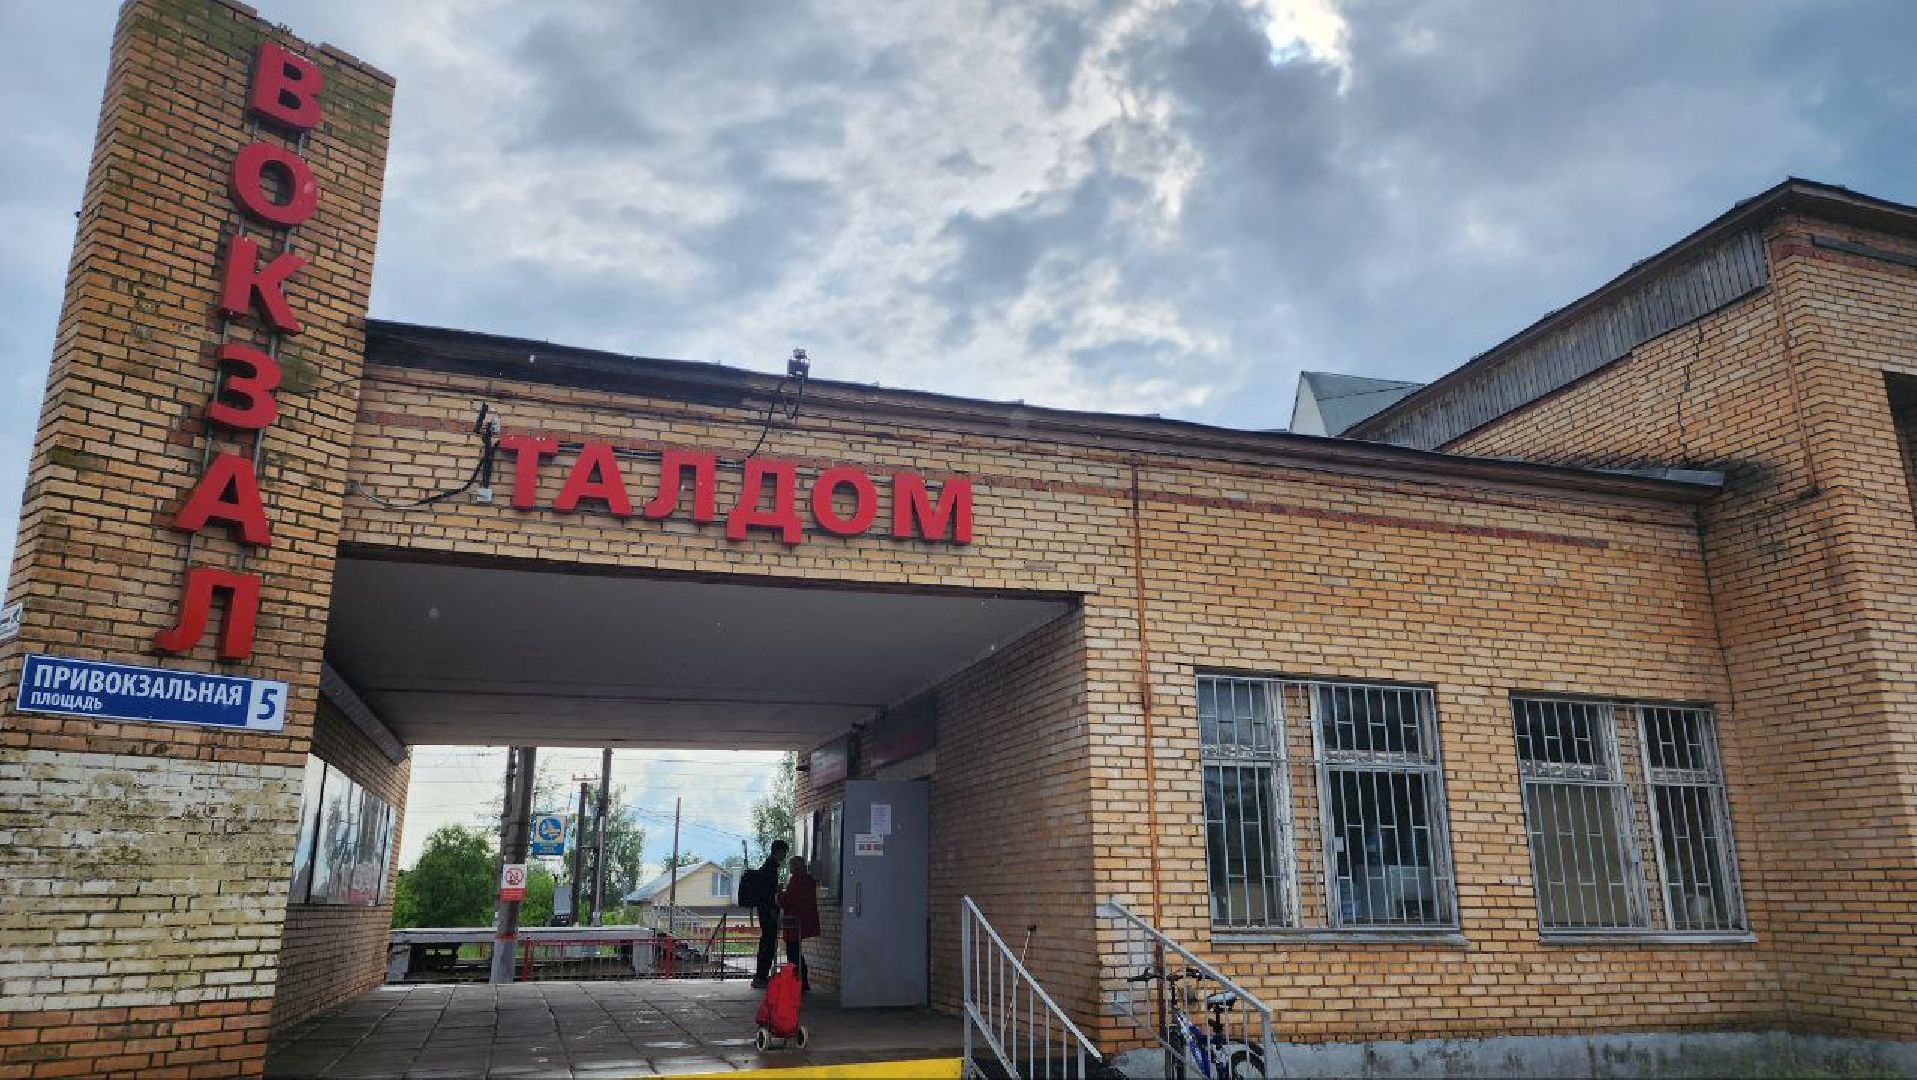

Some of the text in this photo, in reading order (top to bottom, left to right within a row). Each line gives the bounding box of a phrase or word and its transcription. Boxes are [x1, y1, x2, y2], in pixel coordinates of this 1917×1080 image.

[153, 41, 324, 661] ВОКЗАЛ
[499, 435, 974, 546] ТАЛДОМ
[31, 691, 104, 712] ПЛОЩАДЬ
[33, 663, 243, 706] ПРИВОКЗАЛЬНАЯ
[256, 688, 278, 721] 5
